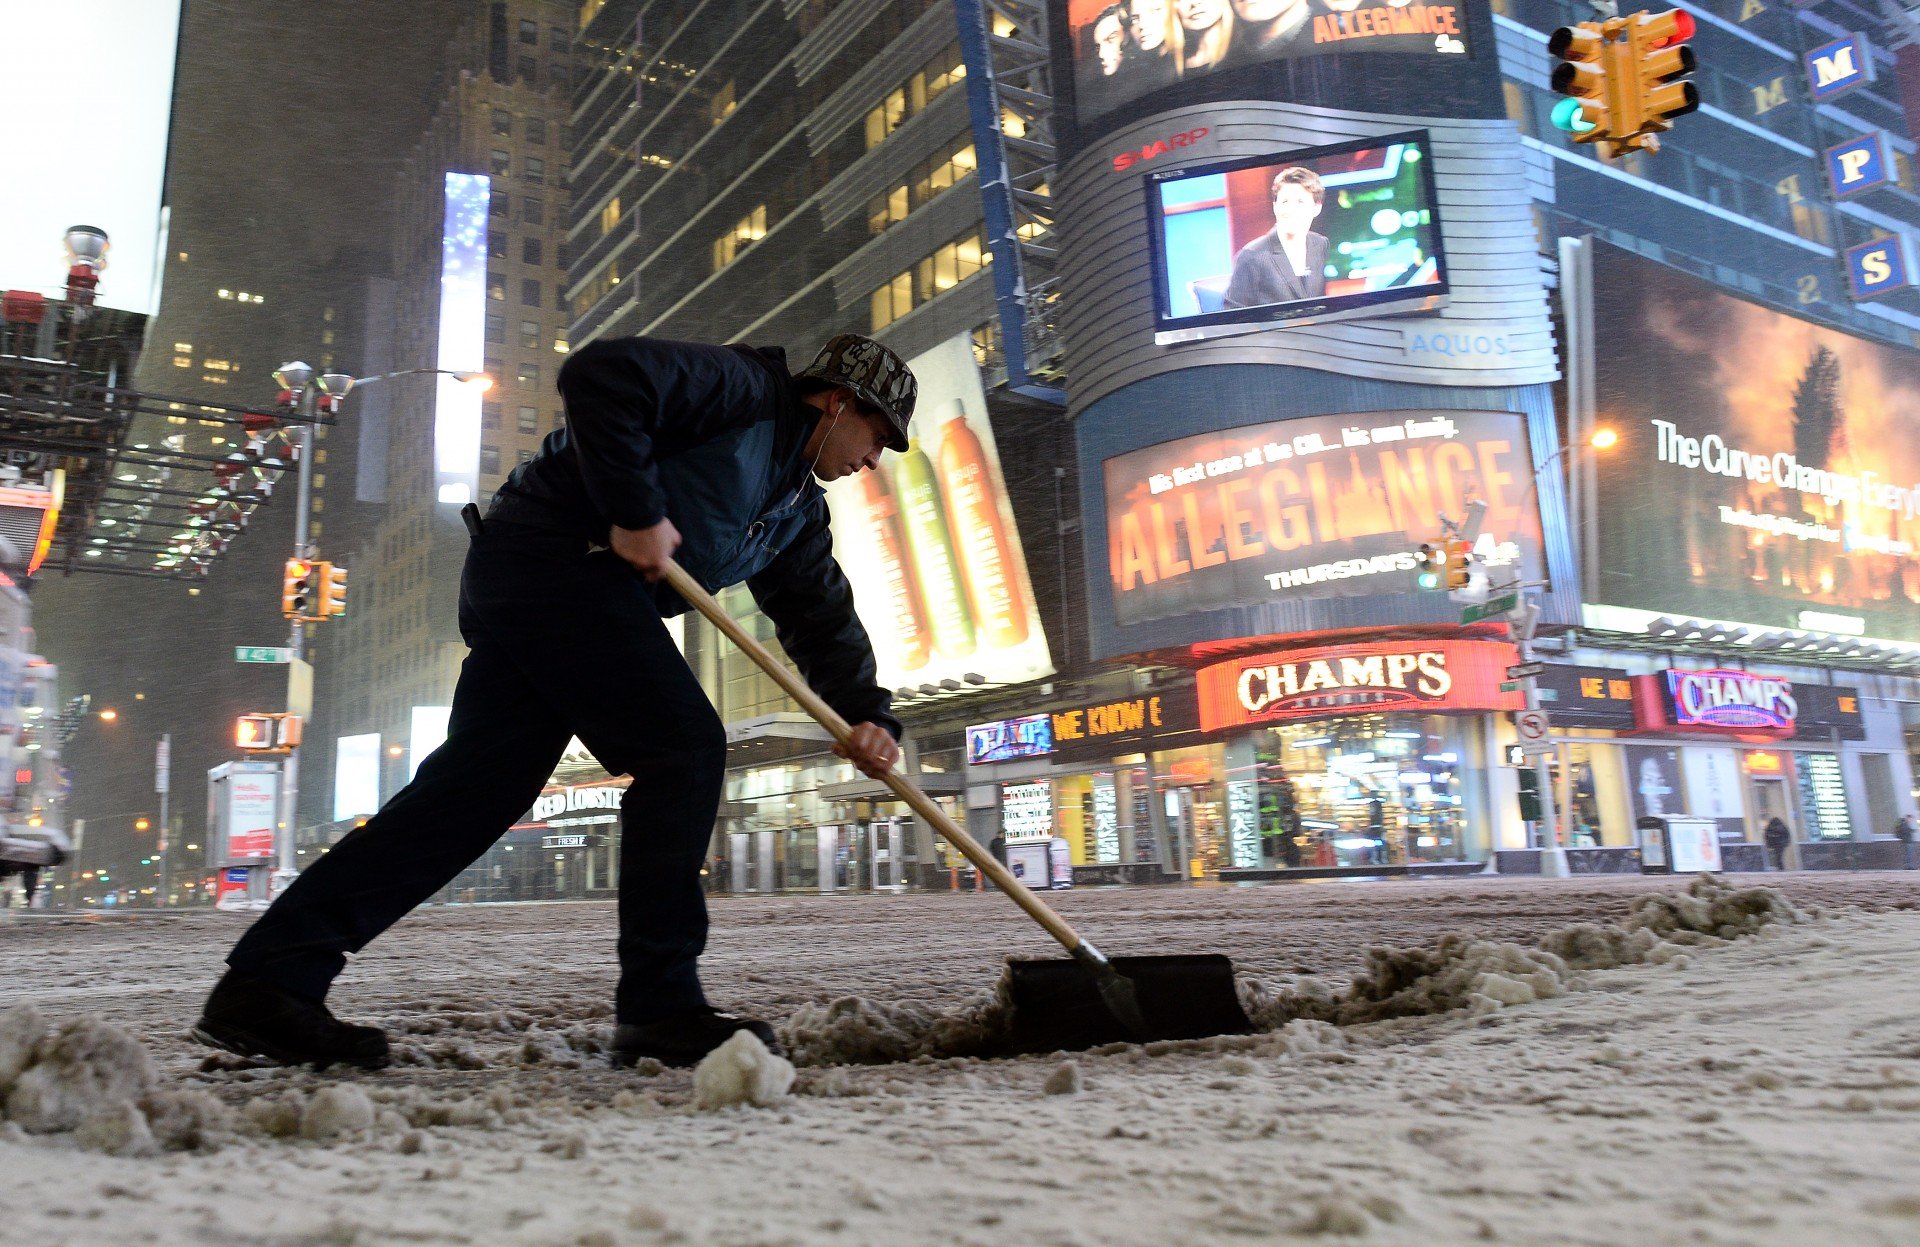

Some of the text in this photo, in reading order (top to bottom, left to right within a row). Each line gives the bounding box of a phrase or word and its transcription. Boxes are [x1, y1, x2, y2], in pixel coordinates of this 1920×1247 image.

[1313, 5, 1461, 43] ALLEGIANCE
[1113, 127, 1209, 171] SHARP
[1411, 334, 1510, 355] AQUOS
[1651, 419, 1700, 468] The
[1701, 434, 1772, 484] Curve
[1771, 452, 1860, 505] Changes
[1120, 439, 1522, 592] ALLEGIANCE
[1264, 551, 1416, 590] THURSDAYS
[1237, 652, 1451, 712] CHAMPS
[1681, 675, 1798, 720] CHAMPS
[1052, 711, 1084, 740] WE
[1087, 700, 1144, 736] KNOW
[532, 794, 566, 821] RED
